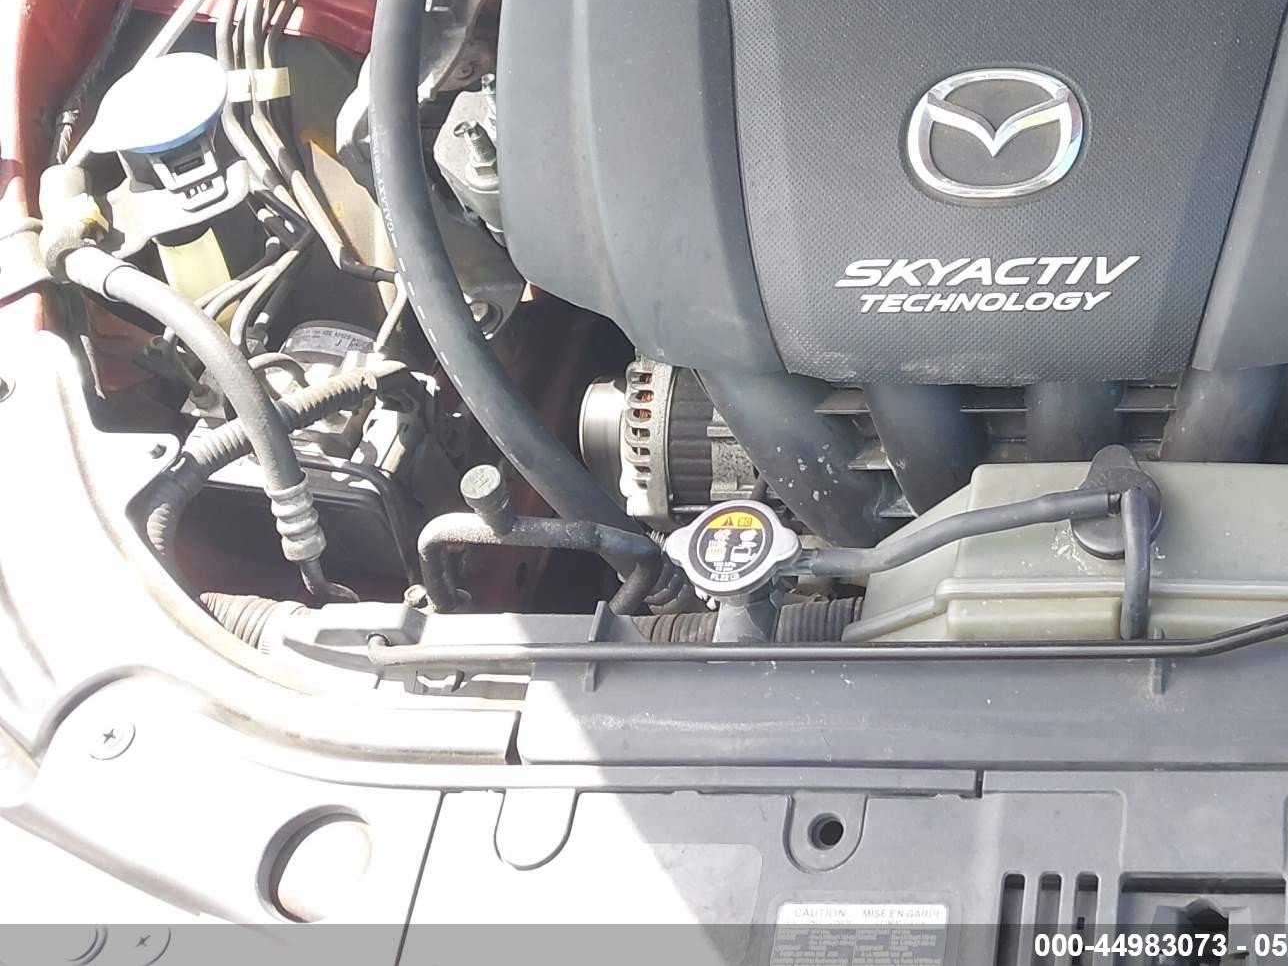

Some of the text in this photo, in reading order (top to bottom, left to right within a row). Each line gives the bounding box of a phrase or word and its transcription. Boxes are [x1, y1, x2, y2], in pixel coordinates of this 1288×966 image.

[376, 177, 395, 232] GALAXY
[835, 255, 1141, 288] SKYACTIV
[858, 291, 1112, 314] TECHNOLOGY
[794, 908, 846, 918] CAUTION
[862, 908, 886, 918] MISE
[889, 908, 904, 918] EN
